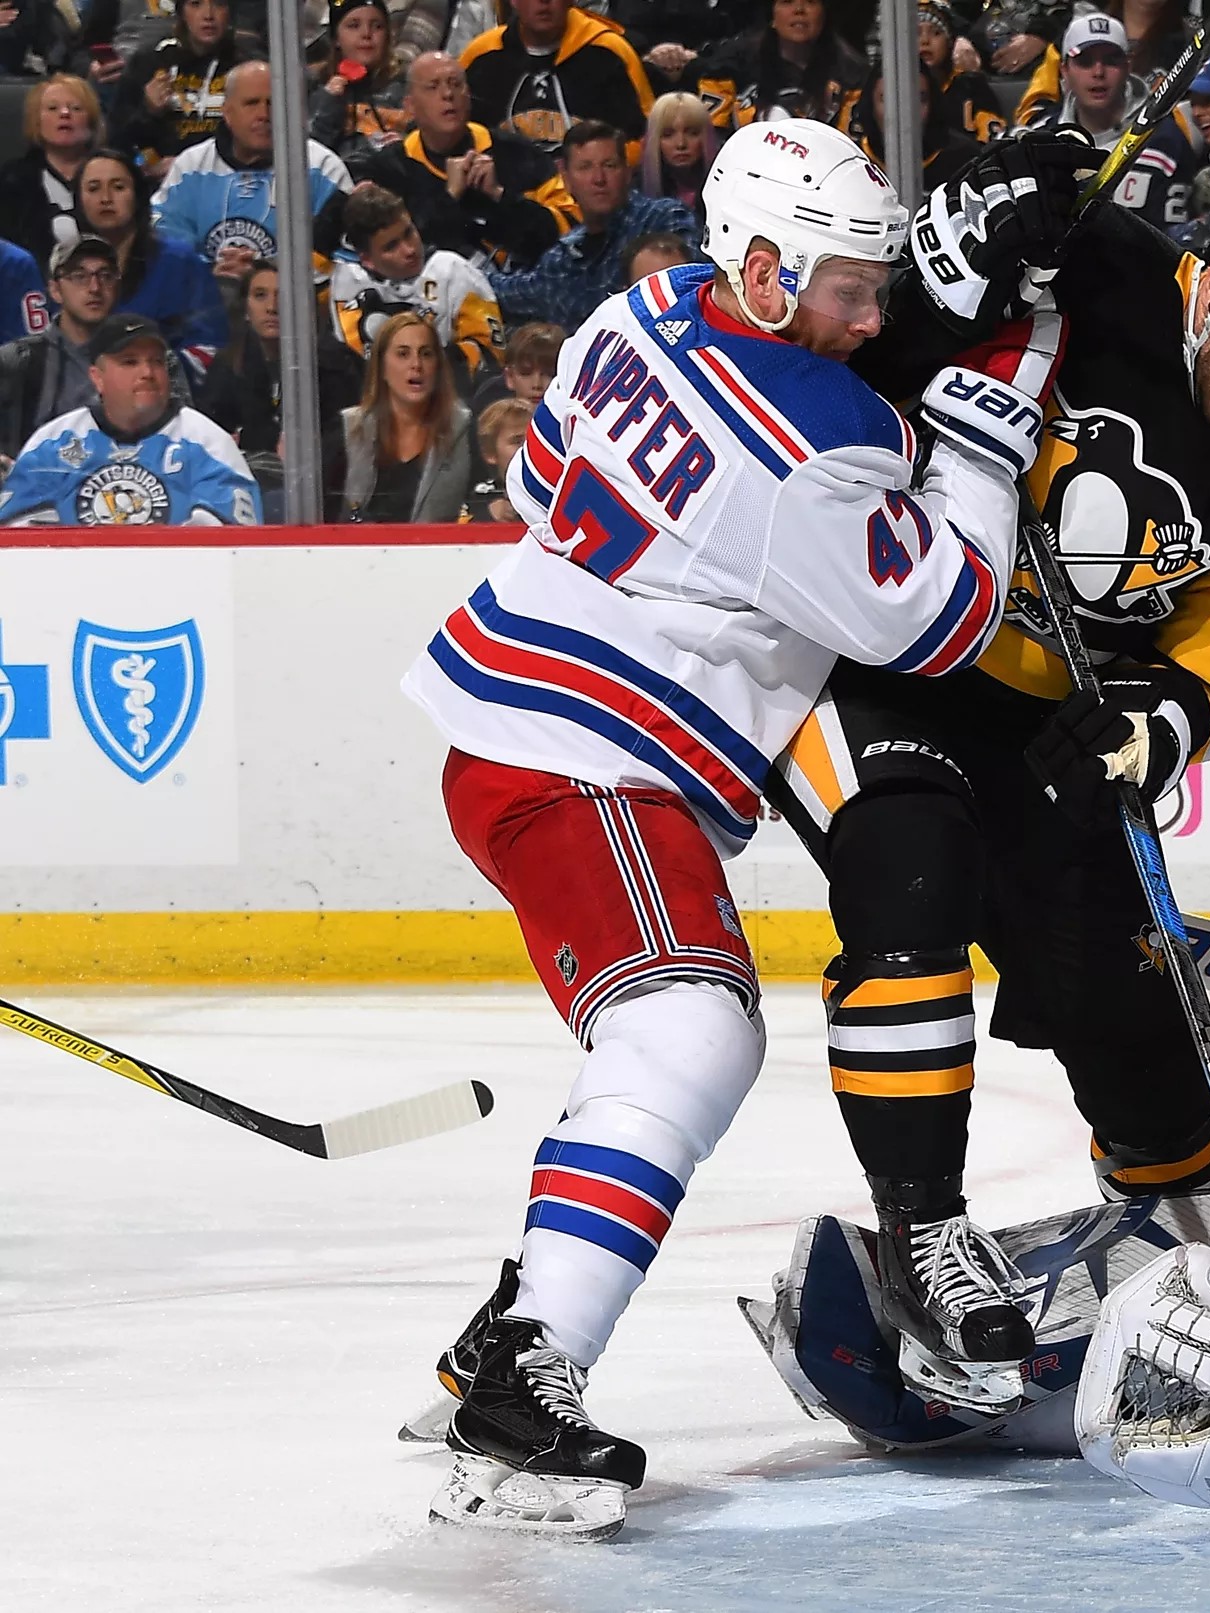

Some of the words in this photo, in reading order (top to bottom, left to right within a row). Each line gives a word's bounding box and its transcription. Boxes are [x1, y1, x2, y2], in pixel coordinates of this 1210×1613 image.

[763, 131, 810, 160] NYR
[1123, 177, 1137, 201] C
[1164, 183, 1192, 224] 2
[423, 280, 438, 301] C
[22, 291, 49, 334] 6
[654, 321, 680, 346] adidas
[941, 371, 1043, 440] UER
[162, 443, 184, 475] C
[80, 464, 169, 508] PITTSBURGH
[867, 489, 933, 588] 47
[1, 1013, 100, 1058] SUPREME
